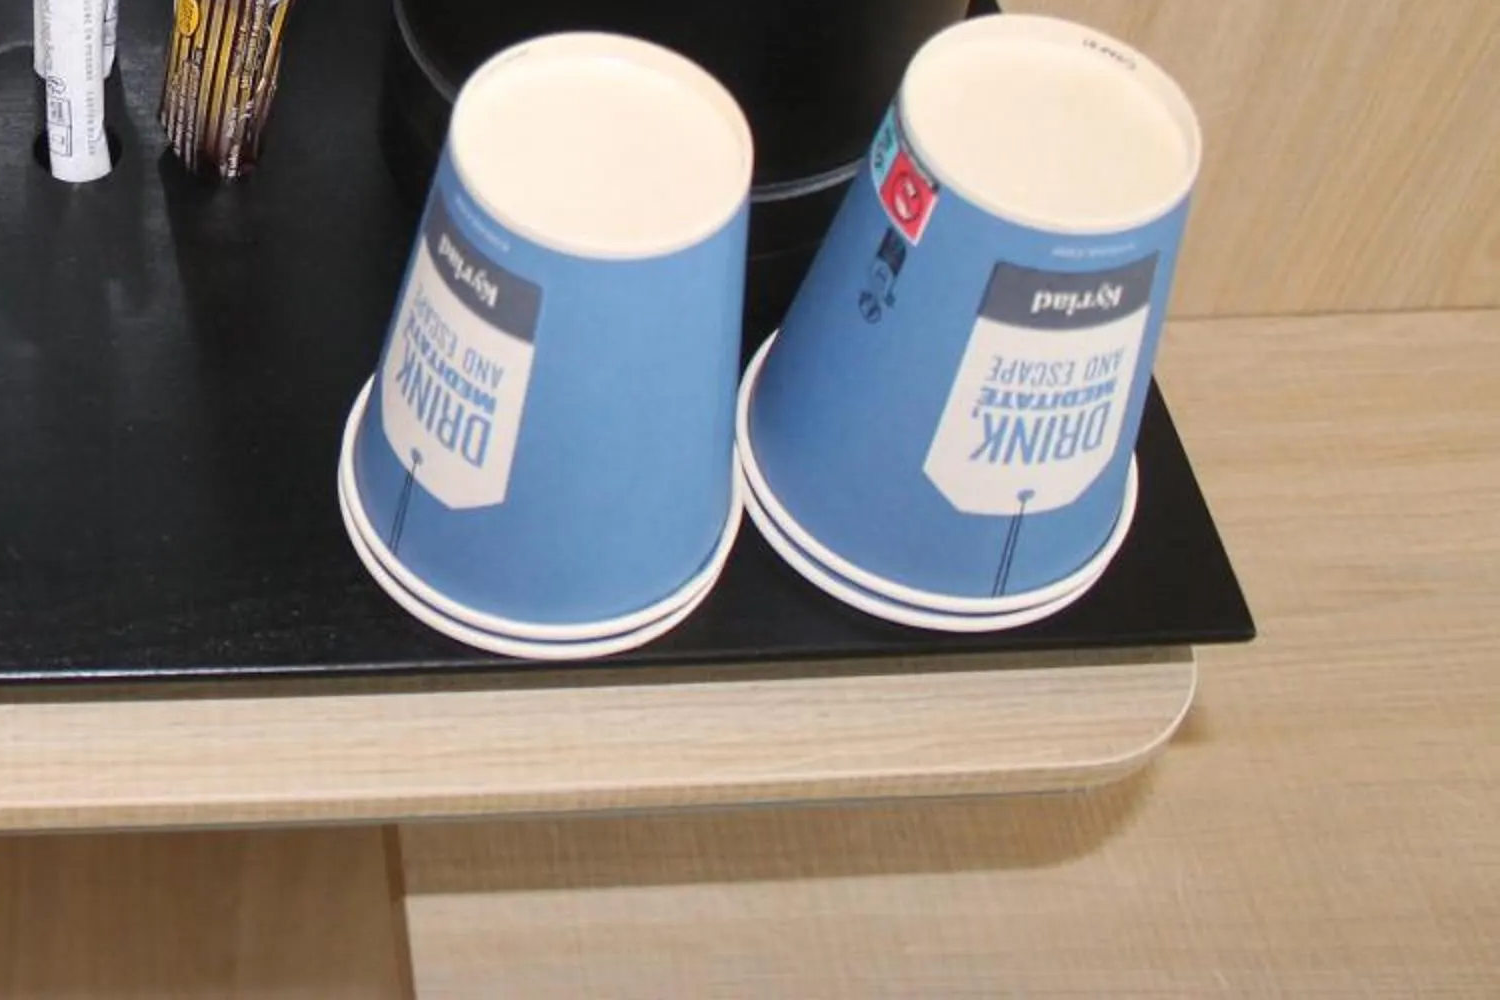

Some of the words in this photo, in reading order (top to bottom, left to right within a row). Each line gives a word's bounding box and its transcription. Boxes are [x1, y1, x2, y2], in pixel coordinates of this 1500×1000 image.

[439, 233, 499, 308] Kyriad
[1031, 282, 1124, 316] Kyriad
[463, 349, 505, 389] AND
[985, 355, 1076, 388] ESCAPE
[1084, 347, 1125, 384] AND
[978, 377, 1118, 411] MEDITATE
[968, 400, 1112, 466] DRINK,
